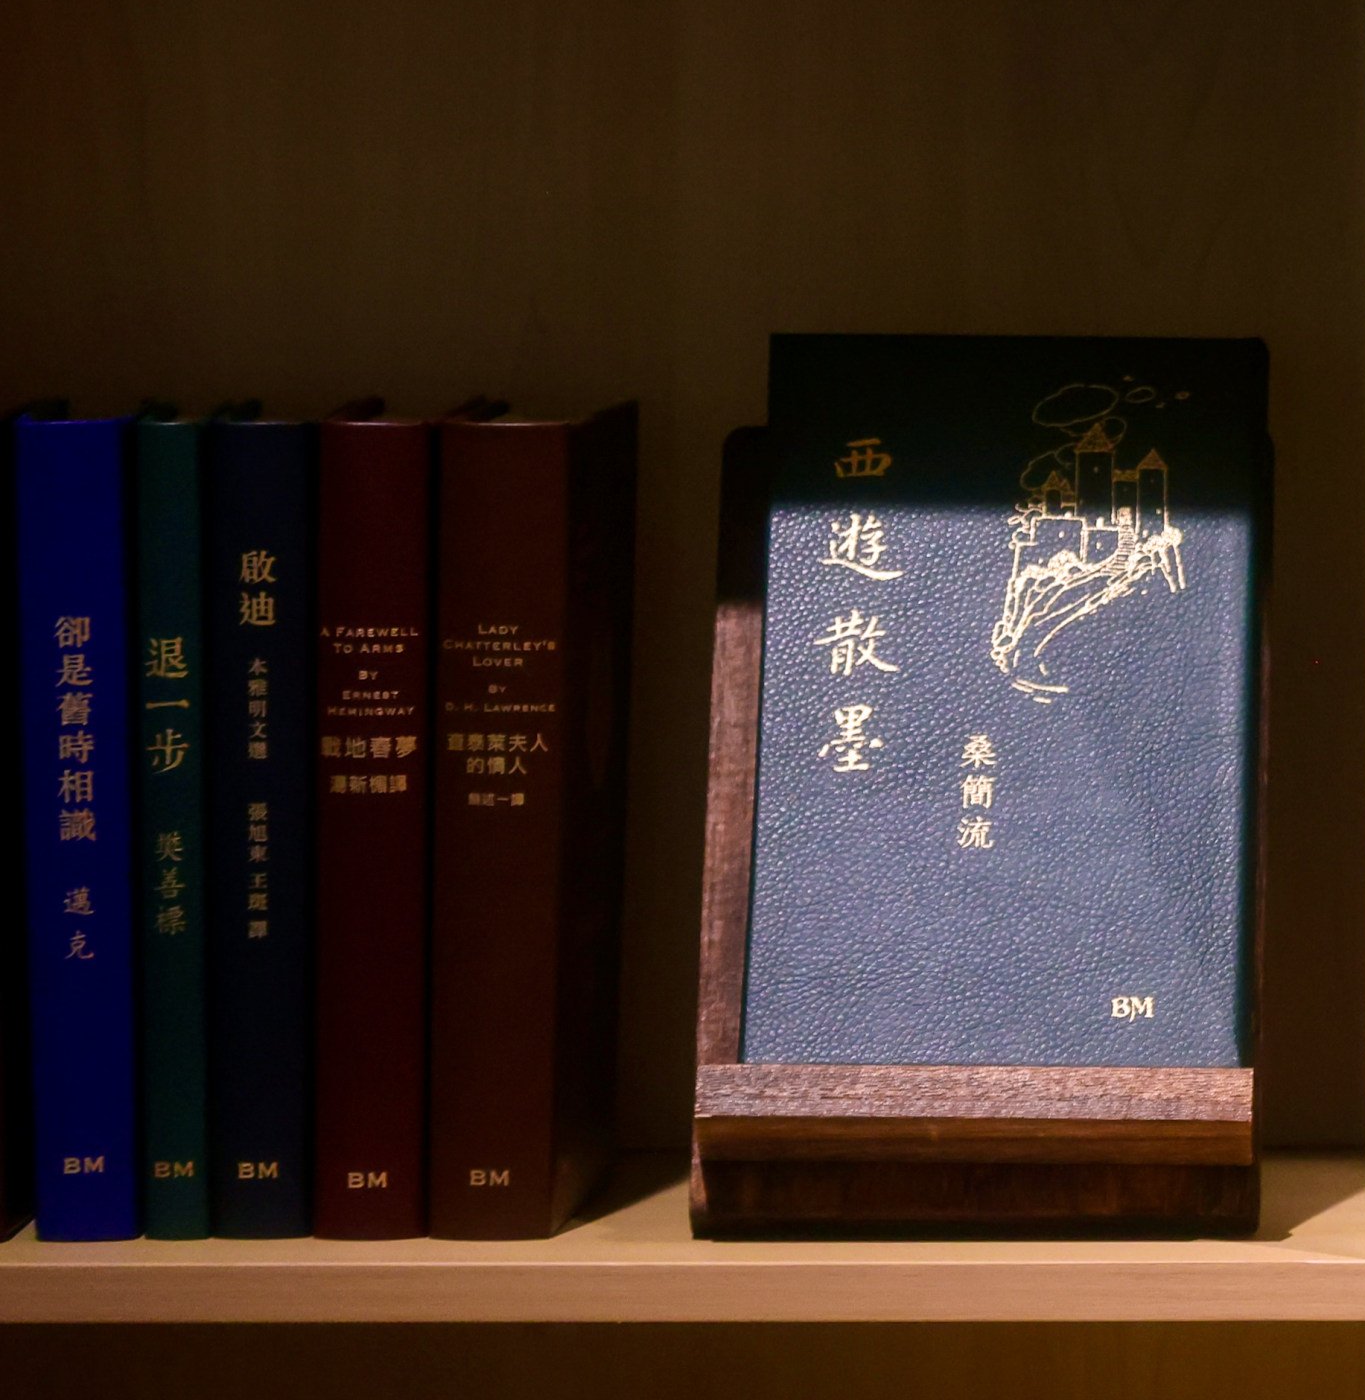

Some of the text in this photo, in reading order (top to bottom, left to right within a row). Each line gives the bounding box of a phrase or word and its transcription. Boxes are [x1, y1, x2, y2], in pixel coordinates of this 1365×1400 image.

[814, 438, 904, 772] 西遊散墨
[145, 636, 190, 775] 退一步
[957, 734, 996, 849] 桑簡流
[1111, 997, 1154, 1020] BM
[63, 1156, 104, 1175] BM
[154, 1160, 195, 1178] BM
[238, 1162, 279, 1179] BM
[348, 1172, 388, 1189] BM
[469, 1170, 510, 1186] BM
